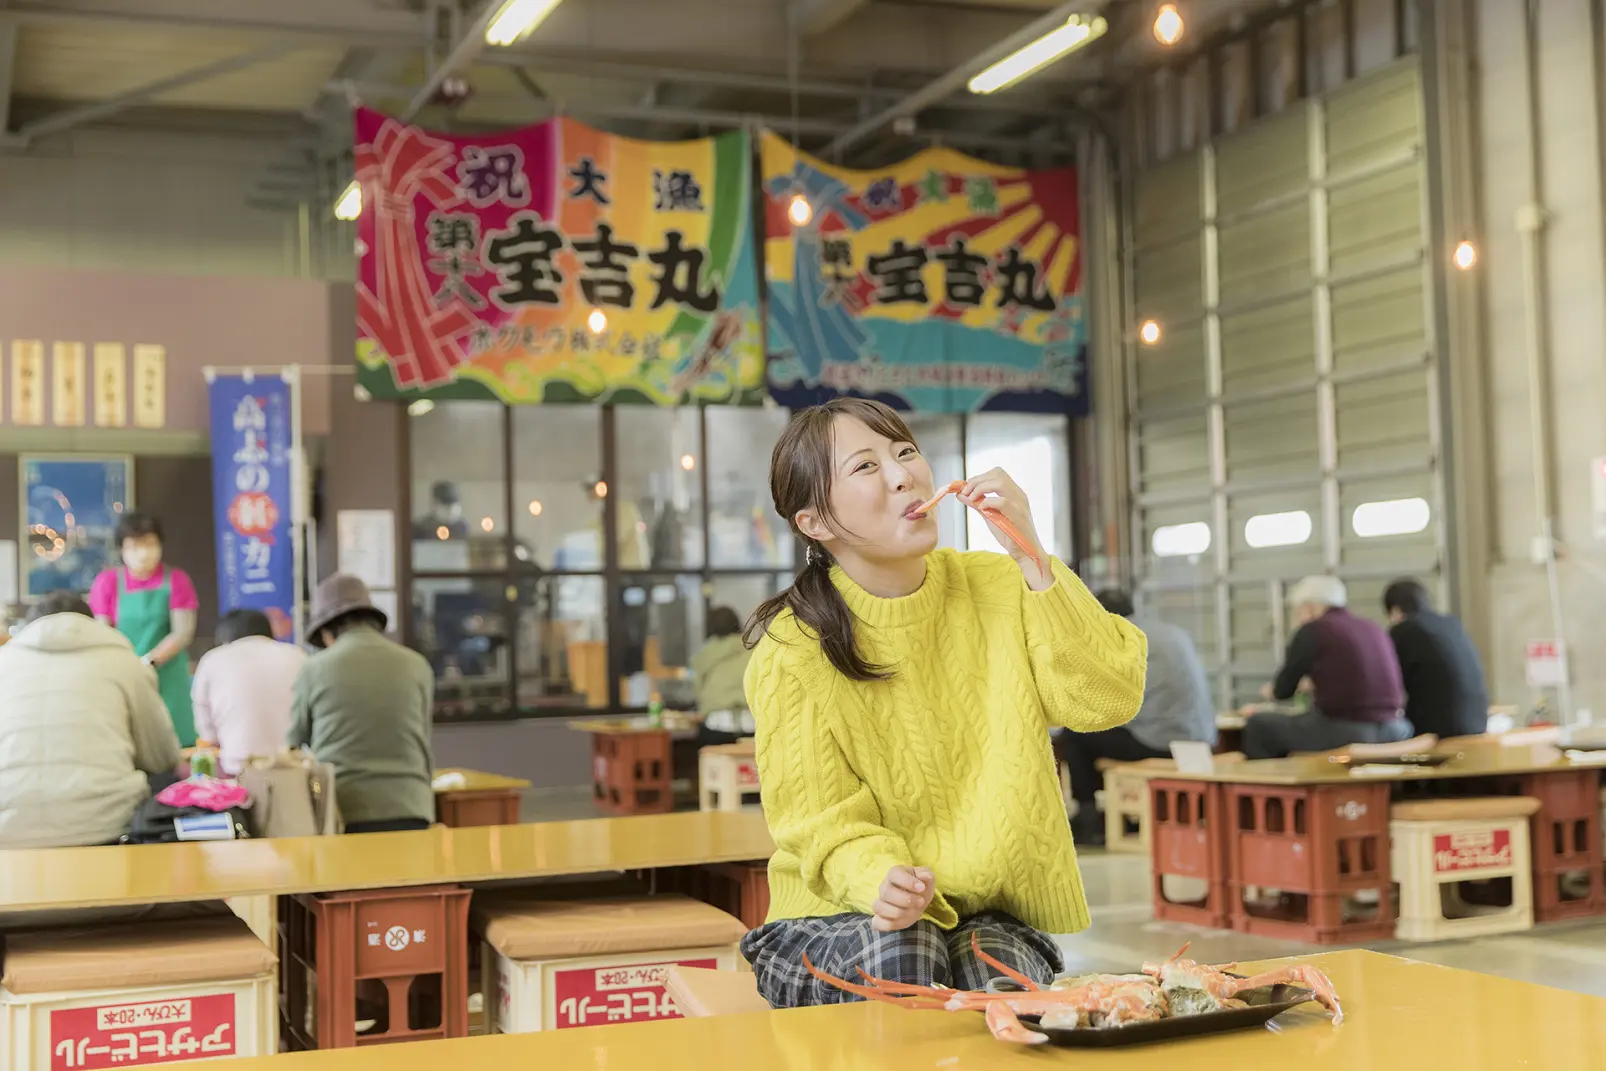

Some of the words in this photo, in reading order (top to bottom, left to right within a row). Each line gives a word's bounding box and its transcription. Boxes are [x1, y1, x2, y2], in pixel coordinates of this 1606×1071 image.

[459, 145, 530, 206] 祝
[489, 218, 718, 312] 宝吉丸
[869, 240, 1055, 311] 宝吉丸
[56, 1023, 231, 1067] アサヒビール
